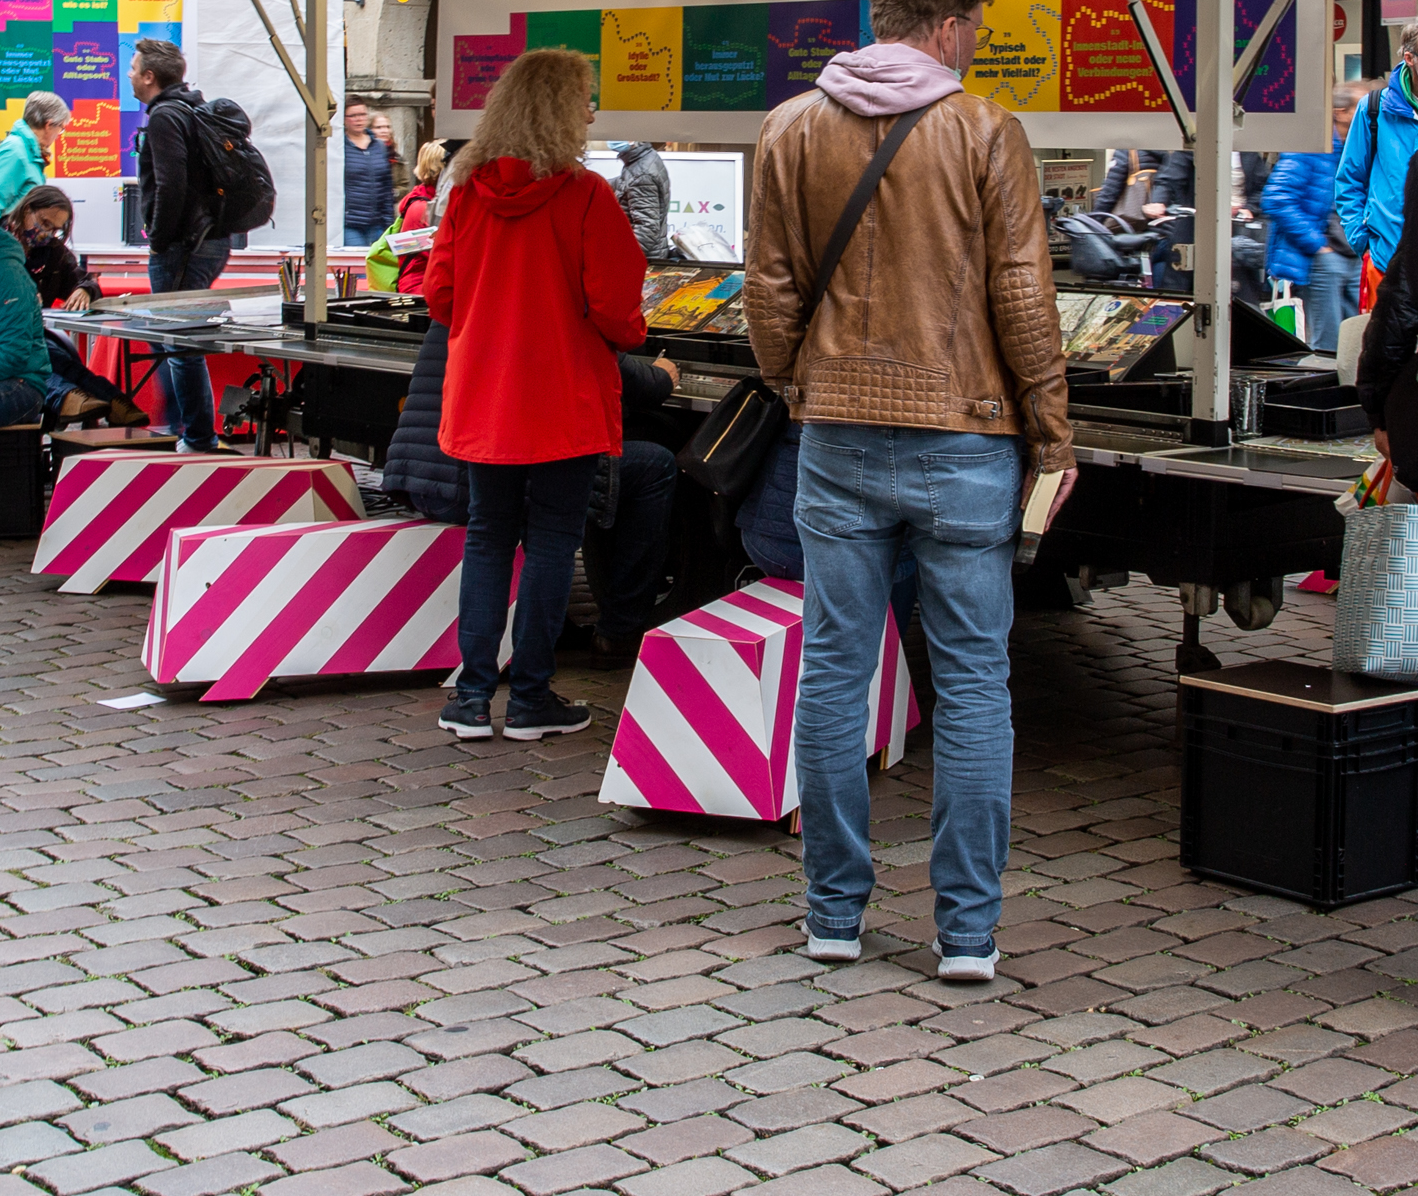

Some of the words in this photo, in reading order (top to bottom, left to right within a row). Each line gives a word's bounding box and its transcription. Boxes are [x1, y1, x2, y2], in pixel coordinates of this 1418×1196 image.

[989, 43, 1026, 55] Typisch
[1073, 41, 1145, 51] Innenstadt-In
[628, 51, 649, 62] Idylle
[712, 50, 738, 59] Immer
[788, 48, 809, 58] Gute
[810, 46, 837, 57] Stube
[801, 59, 823, 69] oder
[971, 56, 1021, 66] nnenstadt
[1024, 56, 1047, 65] oder
[1089, 55, 1112, 64] oder
[1115, 56, 1142, 64] neue
[629, 62, 647, 71] oder
[695, 60, 755, 72] herausgeputzt
[617, 73, 659, 83] Großstadt?
[684, 74, 702, 82] oder
[704, 73, 719, 82] Mut
[721, 74, 735, 82] zur
[736, 71, 765, 82] Lücke?
[975, 68, 999, 78] mehr
[1001, 68, 1041, 78] Vielfalt?
[1078, 67, 1154, 79] Verbindungen?
